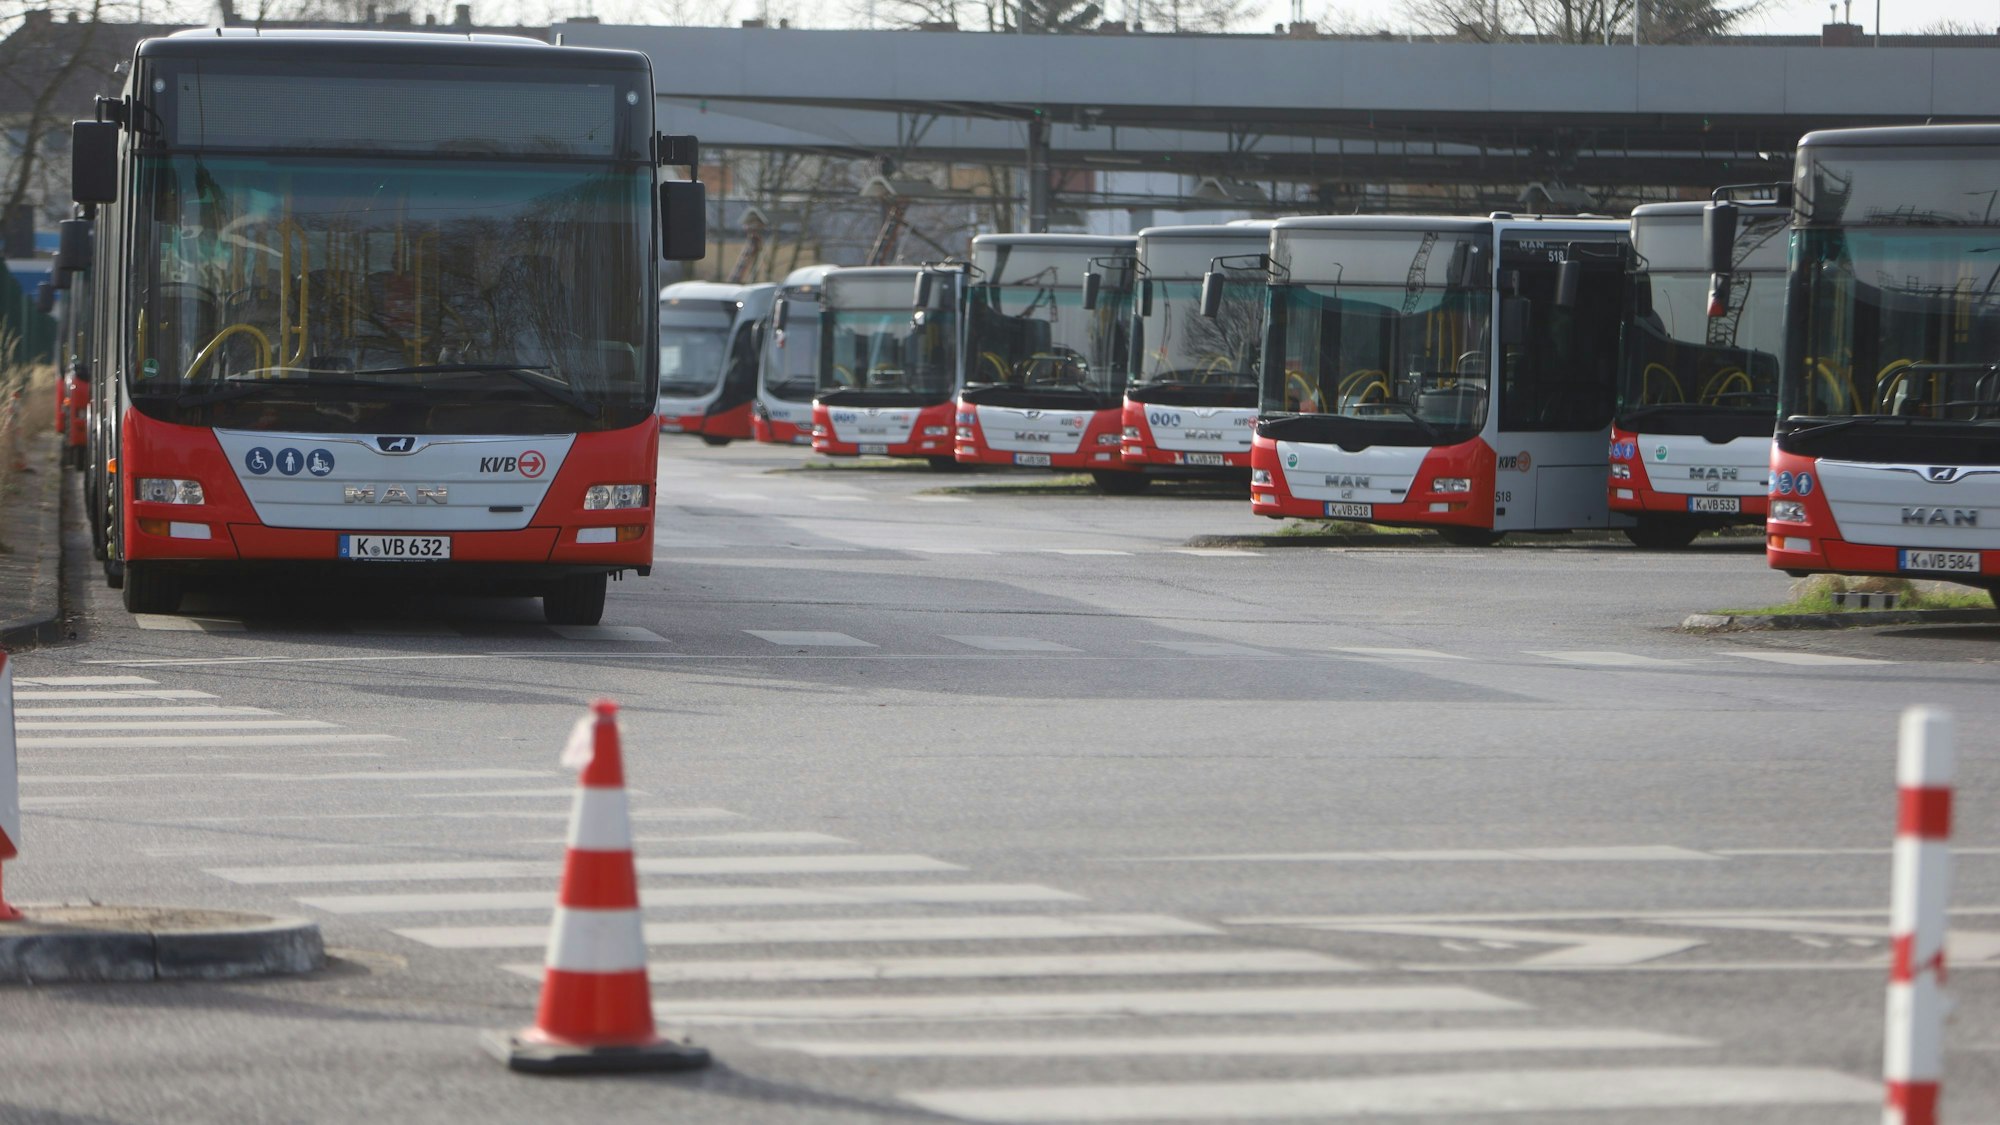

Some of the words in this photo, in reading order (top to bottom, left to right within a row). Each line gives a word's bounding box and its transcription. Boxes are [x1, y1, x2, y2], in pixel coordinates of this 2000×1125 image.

[1519, 240, 1544, 248] MAN
[1548, 250, 1564, 262] 518
[1015, 431, 1050, 442] MAN
[479, 456, 517, 473] KVB
[1498, 456, 1517, 469] KVB
[1689, 467, 1738, 480] MAN
[1325, 475, 1371, 488] MAN
[344, 483, 448, 504] MAN
[1495, 491, 1512, 503] 518
[1331, 504, 1337, 515] K
[1342, 504, 1353, 516] VB
[1353, 505, 1369, 517] 518
[1696, 499, 1702, 510] K
[1707, 499, 1719, 510] VB
[1719, 499, 1736, 511] 533
[1901, 507, 1979, 526] MAN
[357, 538, 369, 555] K
[382, 538, 405, 556] VB
[409, 538, 442, 556] 632
[1911, 552, 1920, 568] K
[1928, 553, 1946, 569] VB
[1948, 554, 1974, 570] 584
